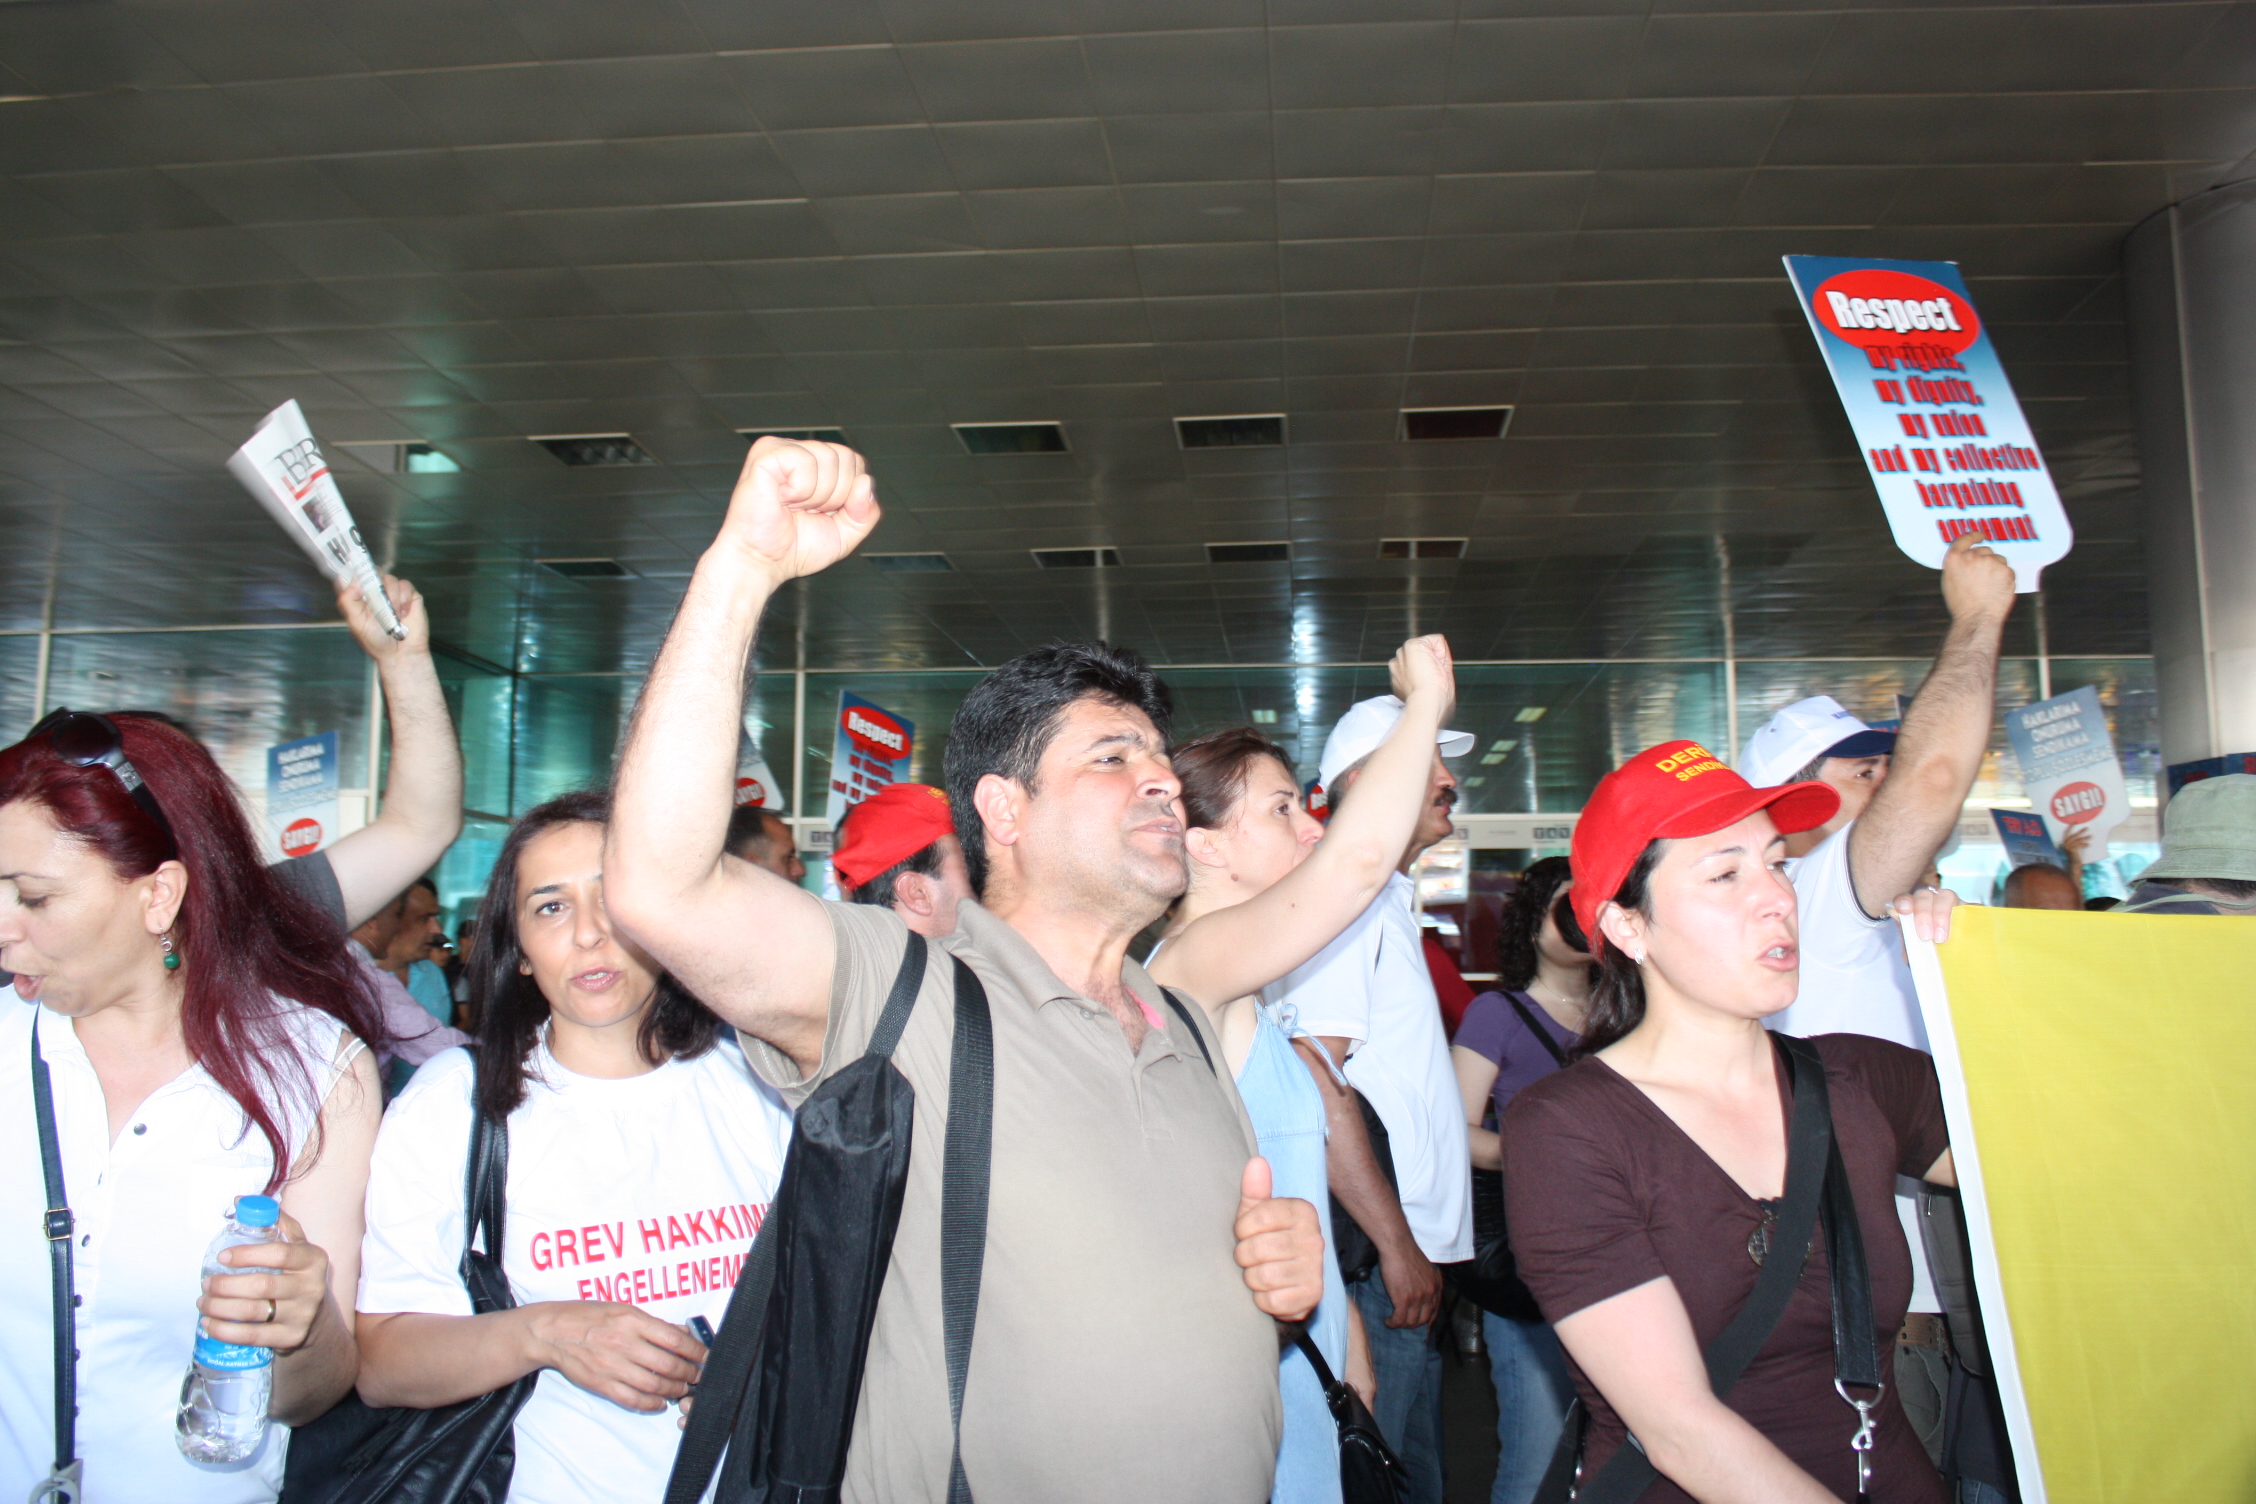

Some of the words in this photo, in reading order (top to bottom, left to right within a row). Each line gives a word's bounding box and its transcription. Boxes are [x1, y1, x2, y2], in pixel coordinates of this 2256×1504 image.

[1825, 291, 1962, 334] Respect
[1863, 345, 1897, 370] my
[1873, 379, 1905, 404] my
[1897, 412, 1929, 439] my
[1930, 409, 1988, 436] union
[1869, 444, 1910, 472] and
[1910, 448, 1941, 473] my
[1943, 443, 2040, 470] collective
[1914, 478, 2025, 509] bargaining
[848, 711, 903, 751] Respect
[2054, 787, 2104, 818] SAYGI!
[530, 1221, 624, 1271] GREV
[637, 1203, 772, 1254] HAKKIM
[577, 1253, 748, 1306] ENGELLENEM
